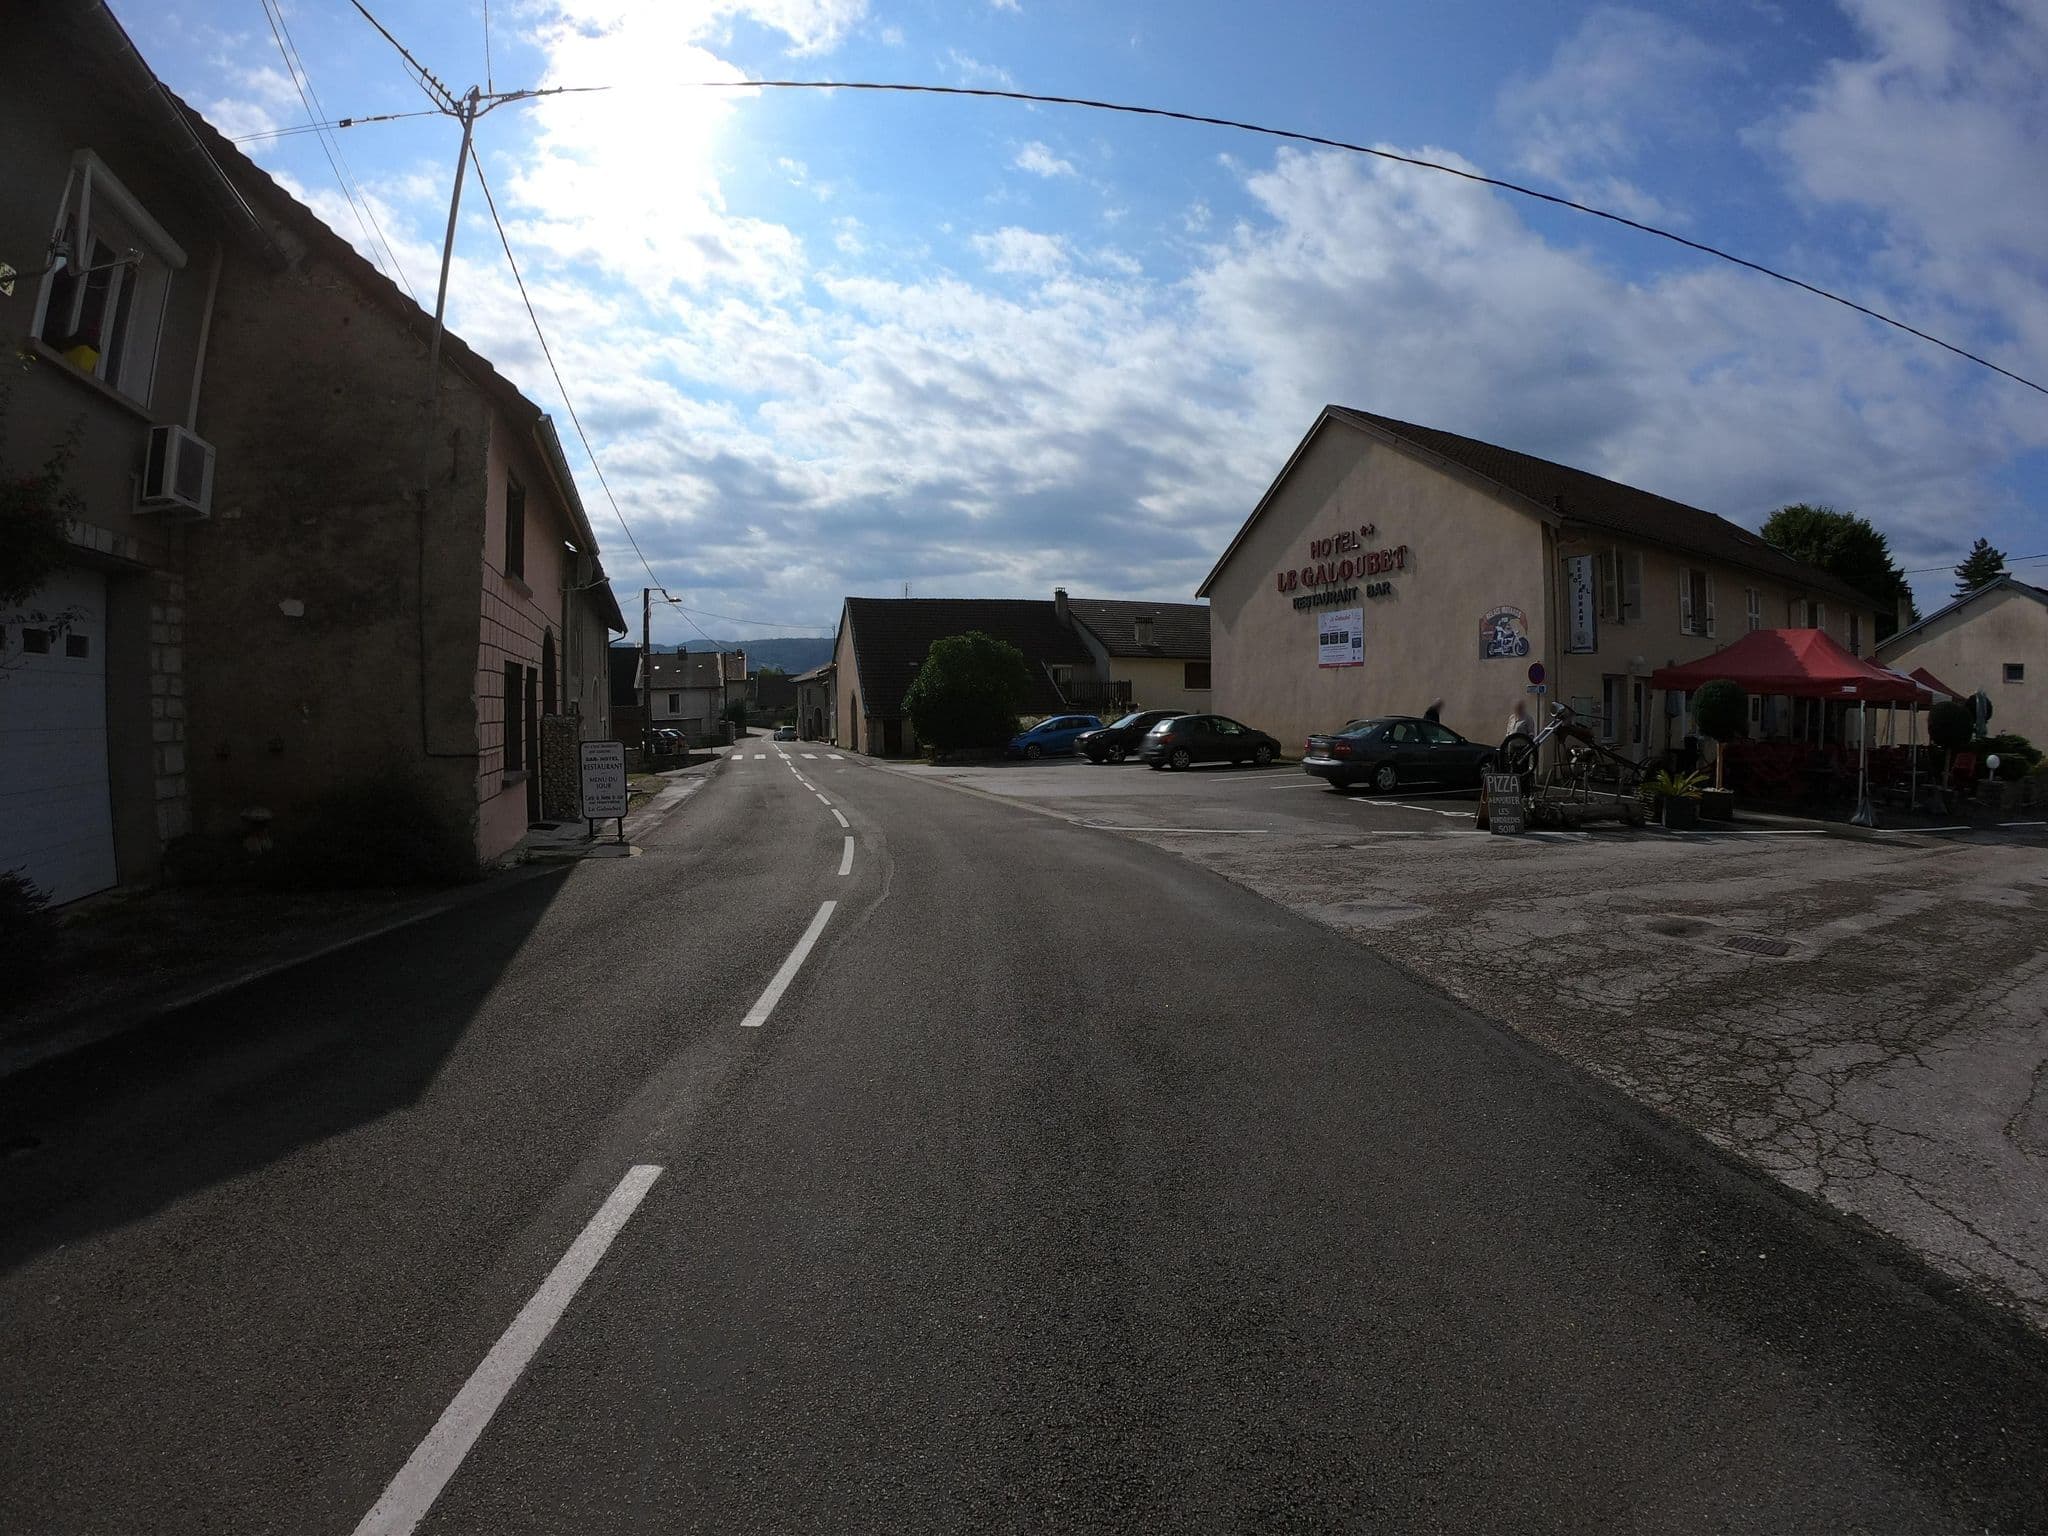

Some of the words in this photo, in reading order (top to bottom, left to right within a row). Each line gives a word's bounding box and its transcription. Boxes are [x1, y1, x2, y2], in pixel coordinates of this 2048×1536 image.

[1311, 530, 1361, 560] HOTEL
[1277, 569, 1297, 592] LE
[1300, 545, 1408, 588] GALOUBET
[1293, 587, 1358, 610] RESTAURANT
[1366, 582, 1391, 598] BAR
[1487, 776, 1519, 793] PIZZA
